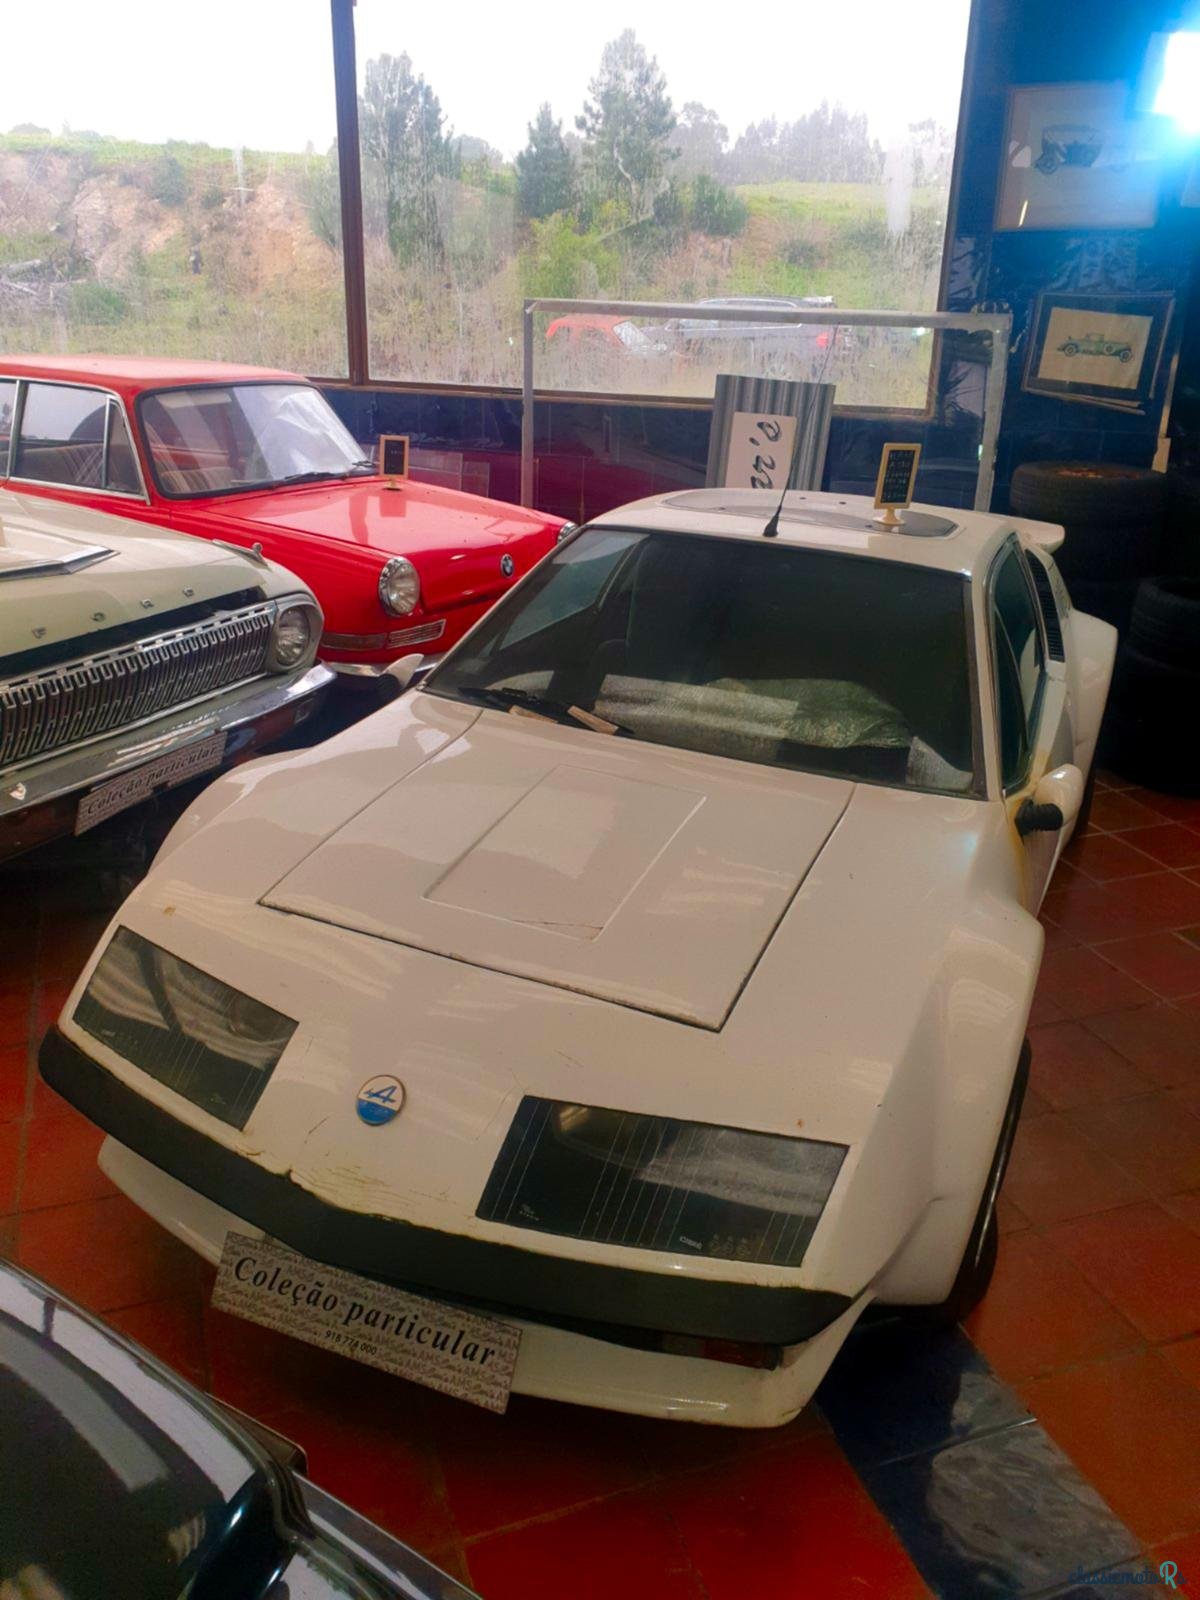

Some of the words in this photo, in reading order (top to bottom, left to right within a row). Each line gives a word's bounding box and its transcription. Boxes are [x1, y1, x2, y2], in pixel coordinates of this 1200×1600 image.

[145, 746, 216, 787] particular
[234, 1256, 338, 1312] Coleção
[342, 1299, 496, 1366] particular
